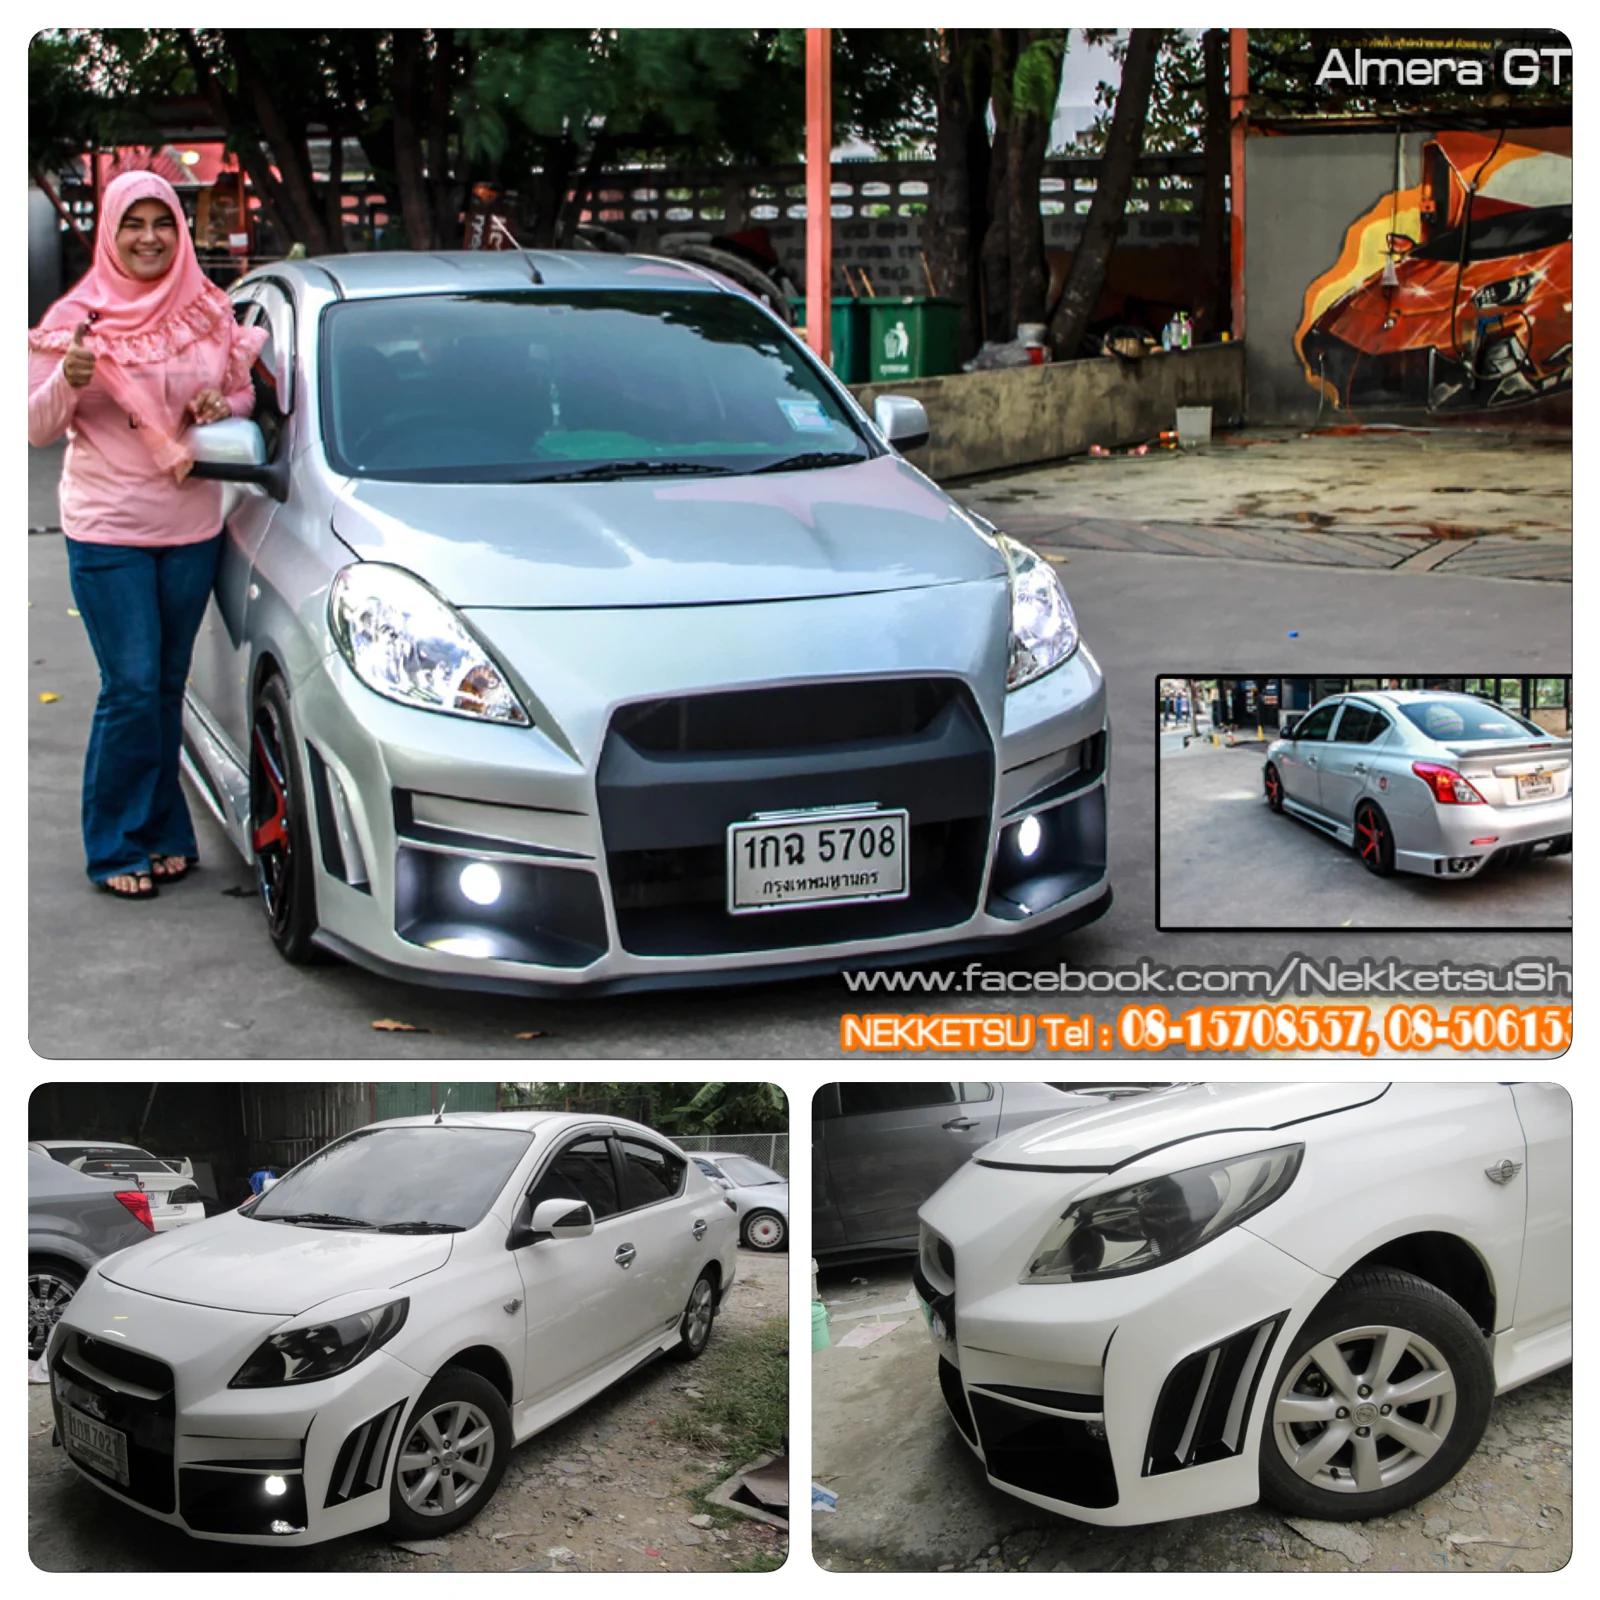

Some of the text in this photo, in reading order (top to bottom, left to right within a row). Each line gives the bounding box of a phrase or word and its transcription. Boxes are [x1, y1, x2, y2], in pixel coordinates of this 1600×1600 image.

[744, 825, 896, 869] 1กฉ 5708
[762, 871, 880, 898] กรุงเทพมหานคร
